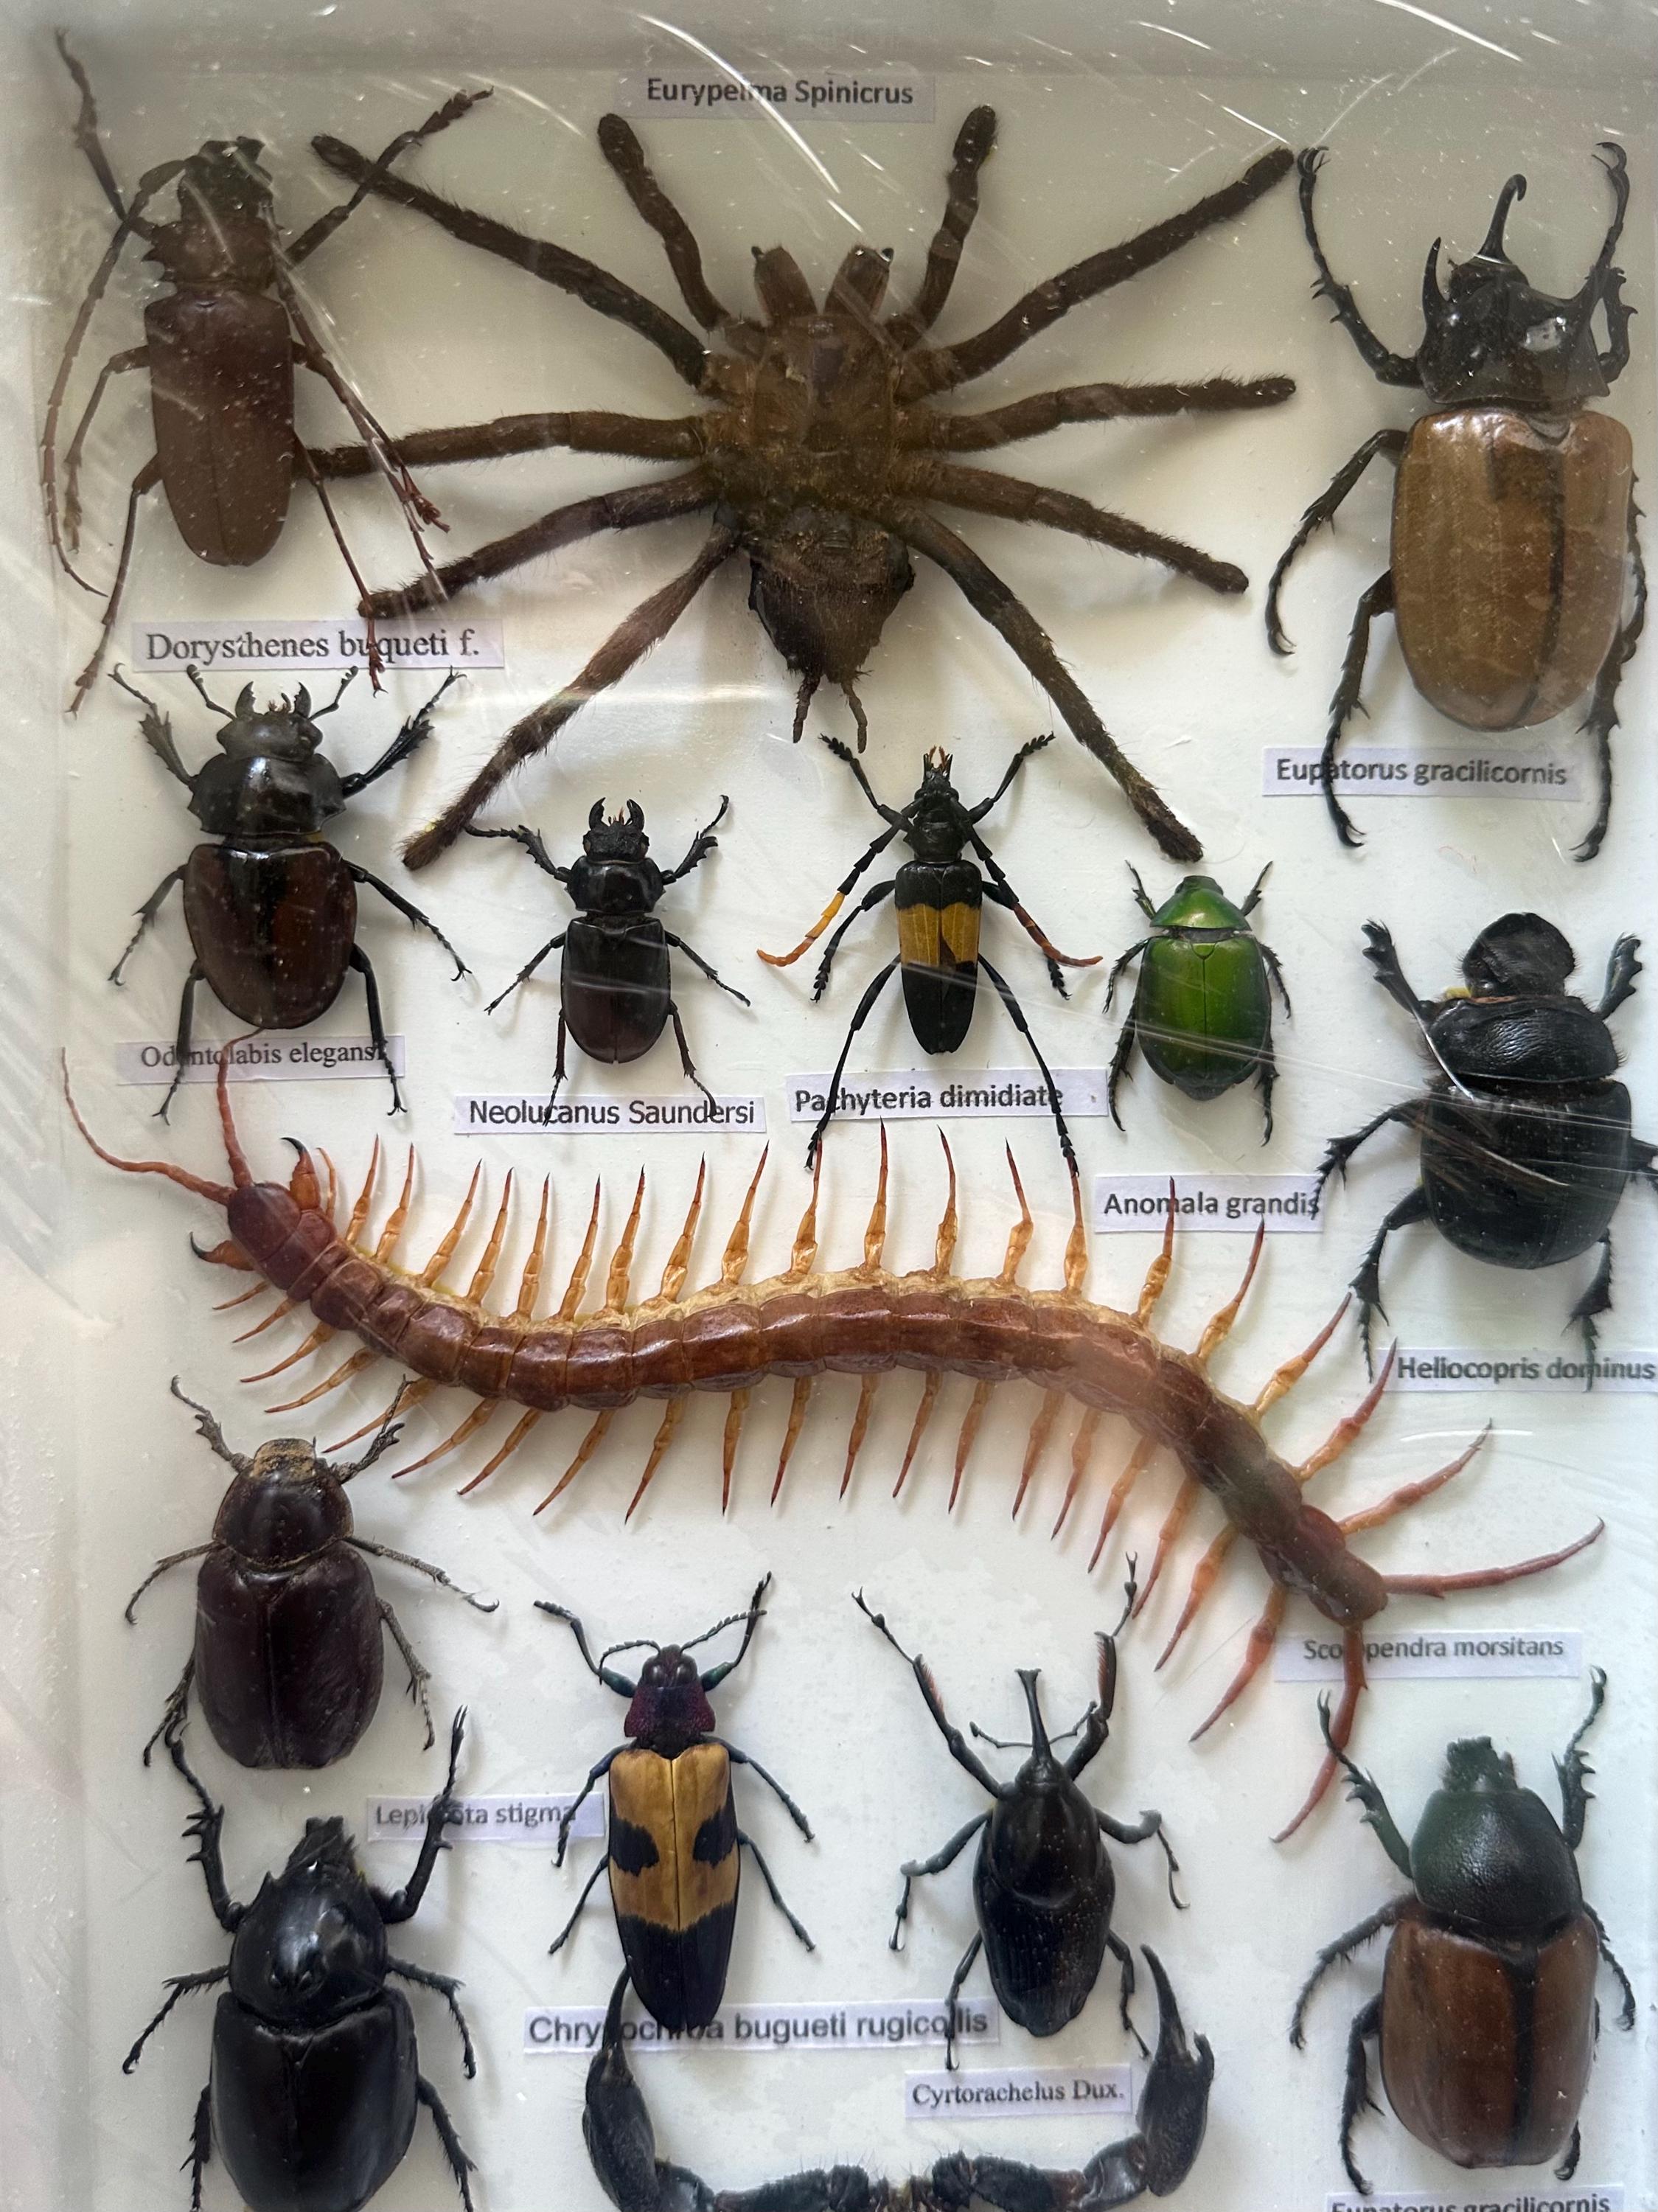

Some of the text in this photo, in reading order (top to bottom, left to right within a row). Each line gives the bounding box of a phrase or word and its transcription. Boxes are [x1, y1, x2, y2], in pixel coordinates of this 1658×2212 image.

[795, 79, 913, 108] Spinicrus
[147, 631, 330, 665] Dorysthenes
[459, 627, 480, 656] f.
[1276, 758, 1567, 786] Eupatorus gracilicornis
[141, 1042, 282, 1068] Odntolabis
[470, 1099, 755, 1125] Neolucanus Saundersi
[1104, 1191, 1320, 1219] Anomala grandis
[1397, 1356, 1657, 1384] Heliocopris dominus
[1303, 1635, 1564, 1663] Scopendra morsitans
[857, 2008, 988, 2042] rugicolis
[1073, 2079, 1125, 2101] Dux.
